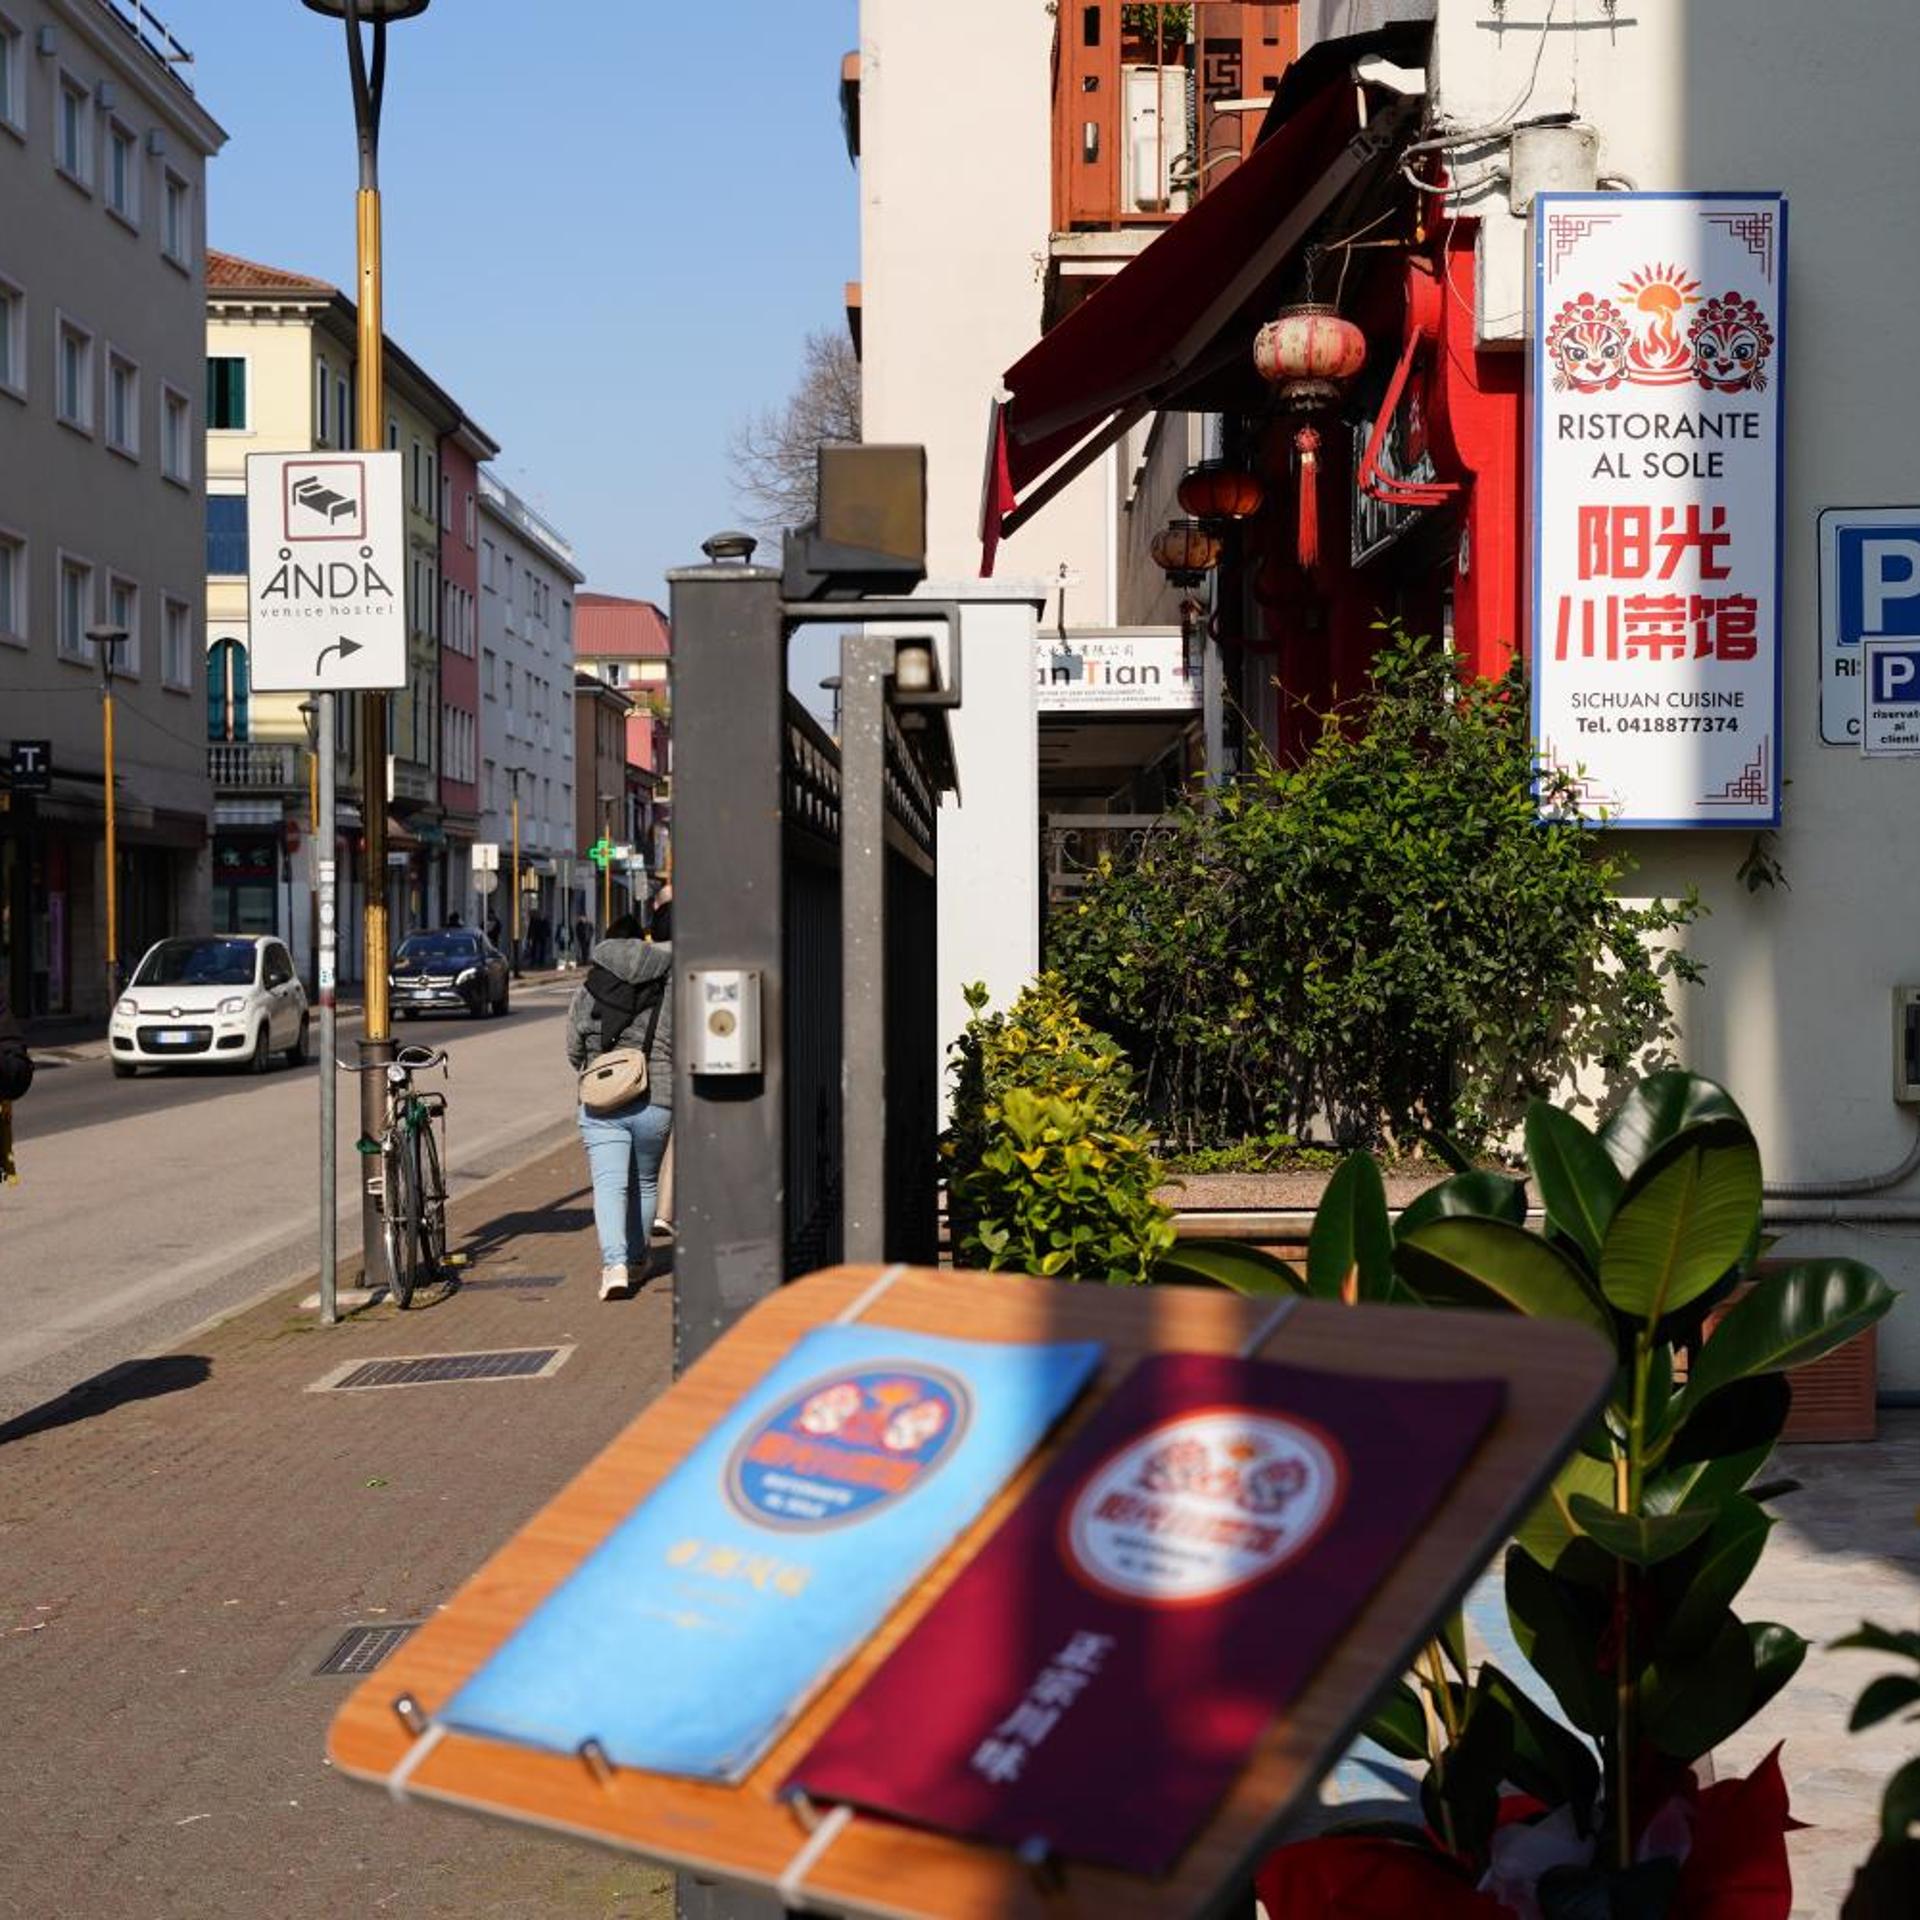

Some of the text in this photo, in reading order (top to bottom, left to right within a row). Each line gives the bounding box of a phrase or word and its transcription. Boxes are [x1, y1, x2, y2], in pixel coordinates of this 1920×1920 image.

[1558, 412, 1760, 440] RISTORANTE
[1592, 452, 1723, 479] AL SOLE
[1577, 504, 1732, 580] 阳光
[260, 603, 393, 619] venice hostel
[1555, 593, 1758, 661] 川菜馆
[1083, 660, 1161, 685] Tian
[1571, 691, 1745, 709] SICHUAN CUISINE
[1873, 708, 1920, 719] riservat
[1576, 716, 1739, 733] Tel. 0418877374
[1880, 733, 1919, 745] clienti
